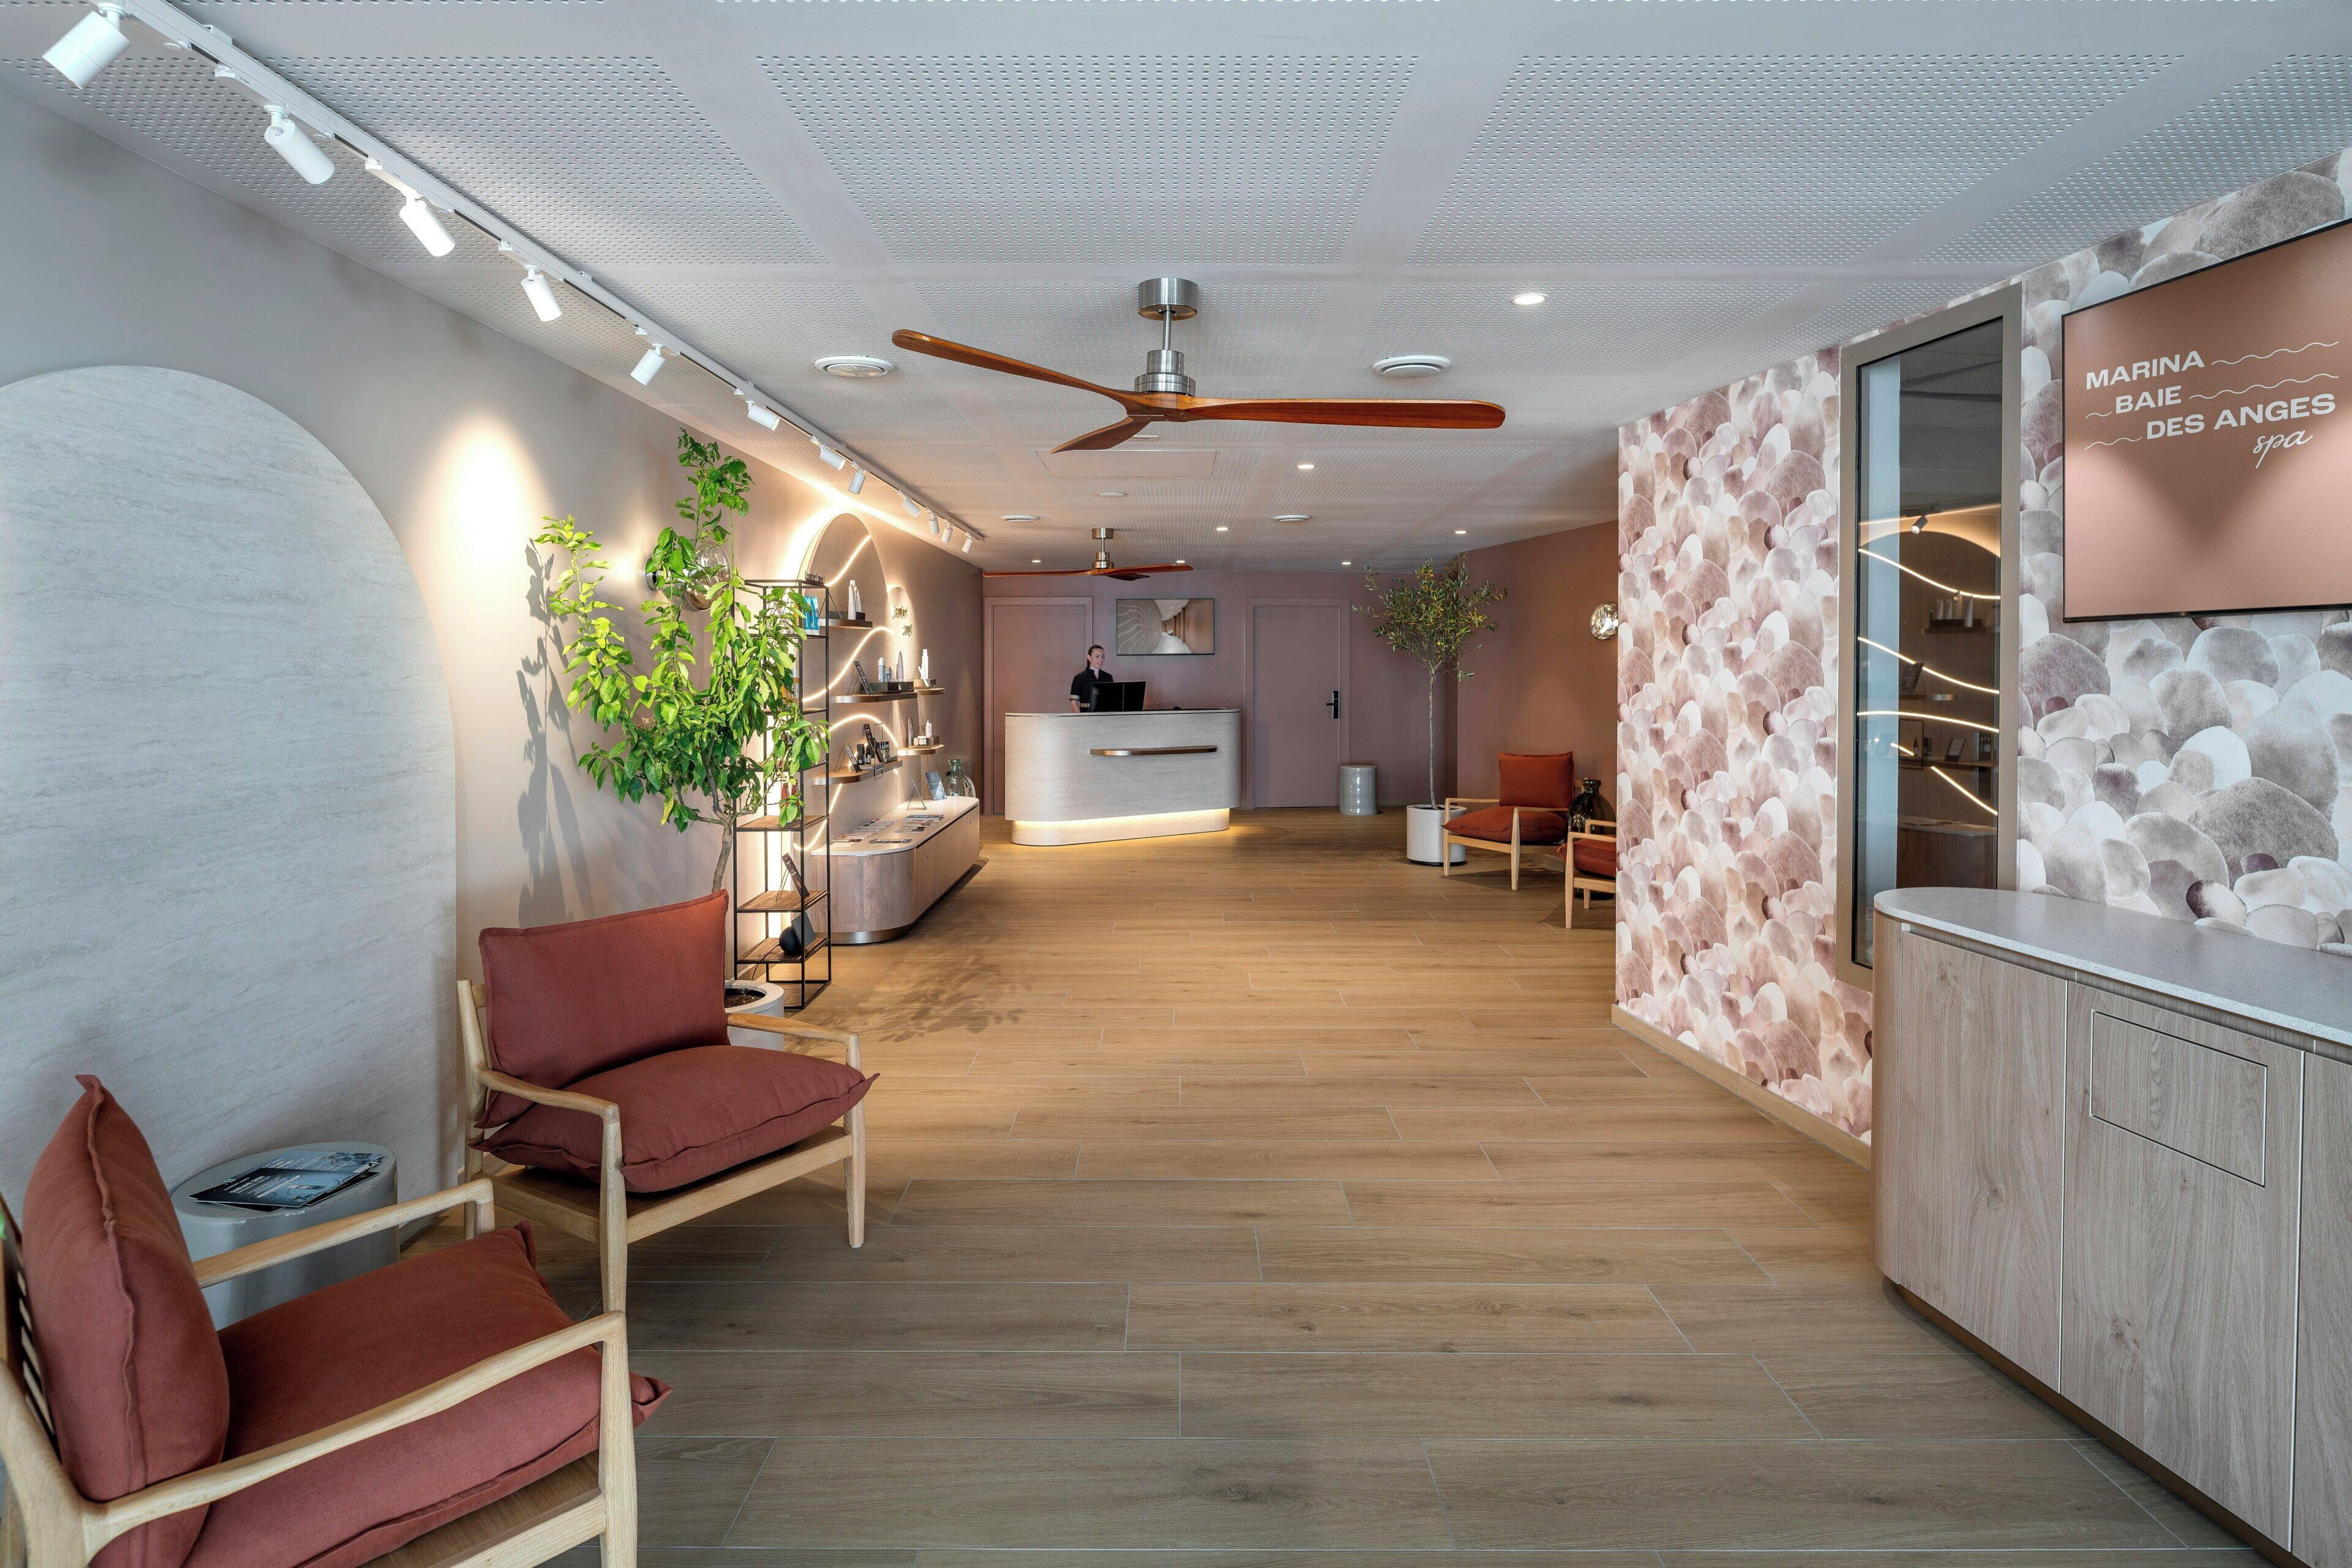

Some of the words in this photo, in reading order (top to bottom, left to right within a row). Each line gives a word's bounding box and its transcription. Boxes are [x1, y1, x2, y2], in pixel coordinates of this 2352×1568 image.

[2086, 350, 2205, 390] MARINA
[2116, 385, 2182, 414] BAIE
[2146, 414, 2205, 440] DES
[2213, 393, 2336, 430] ANGES
[2252, 429, 2314, 469] spa
